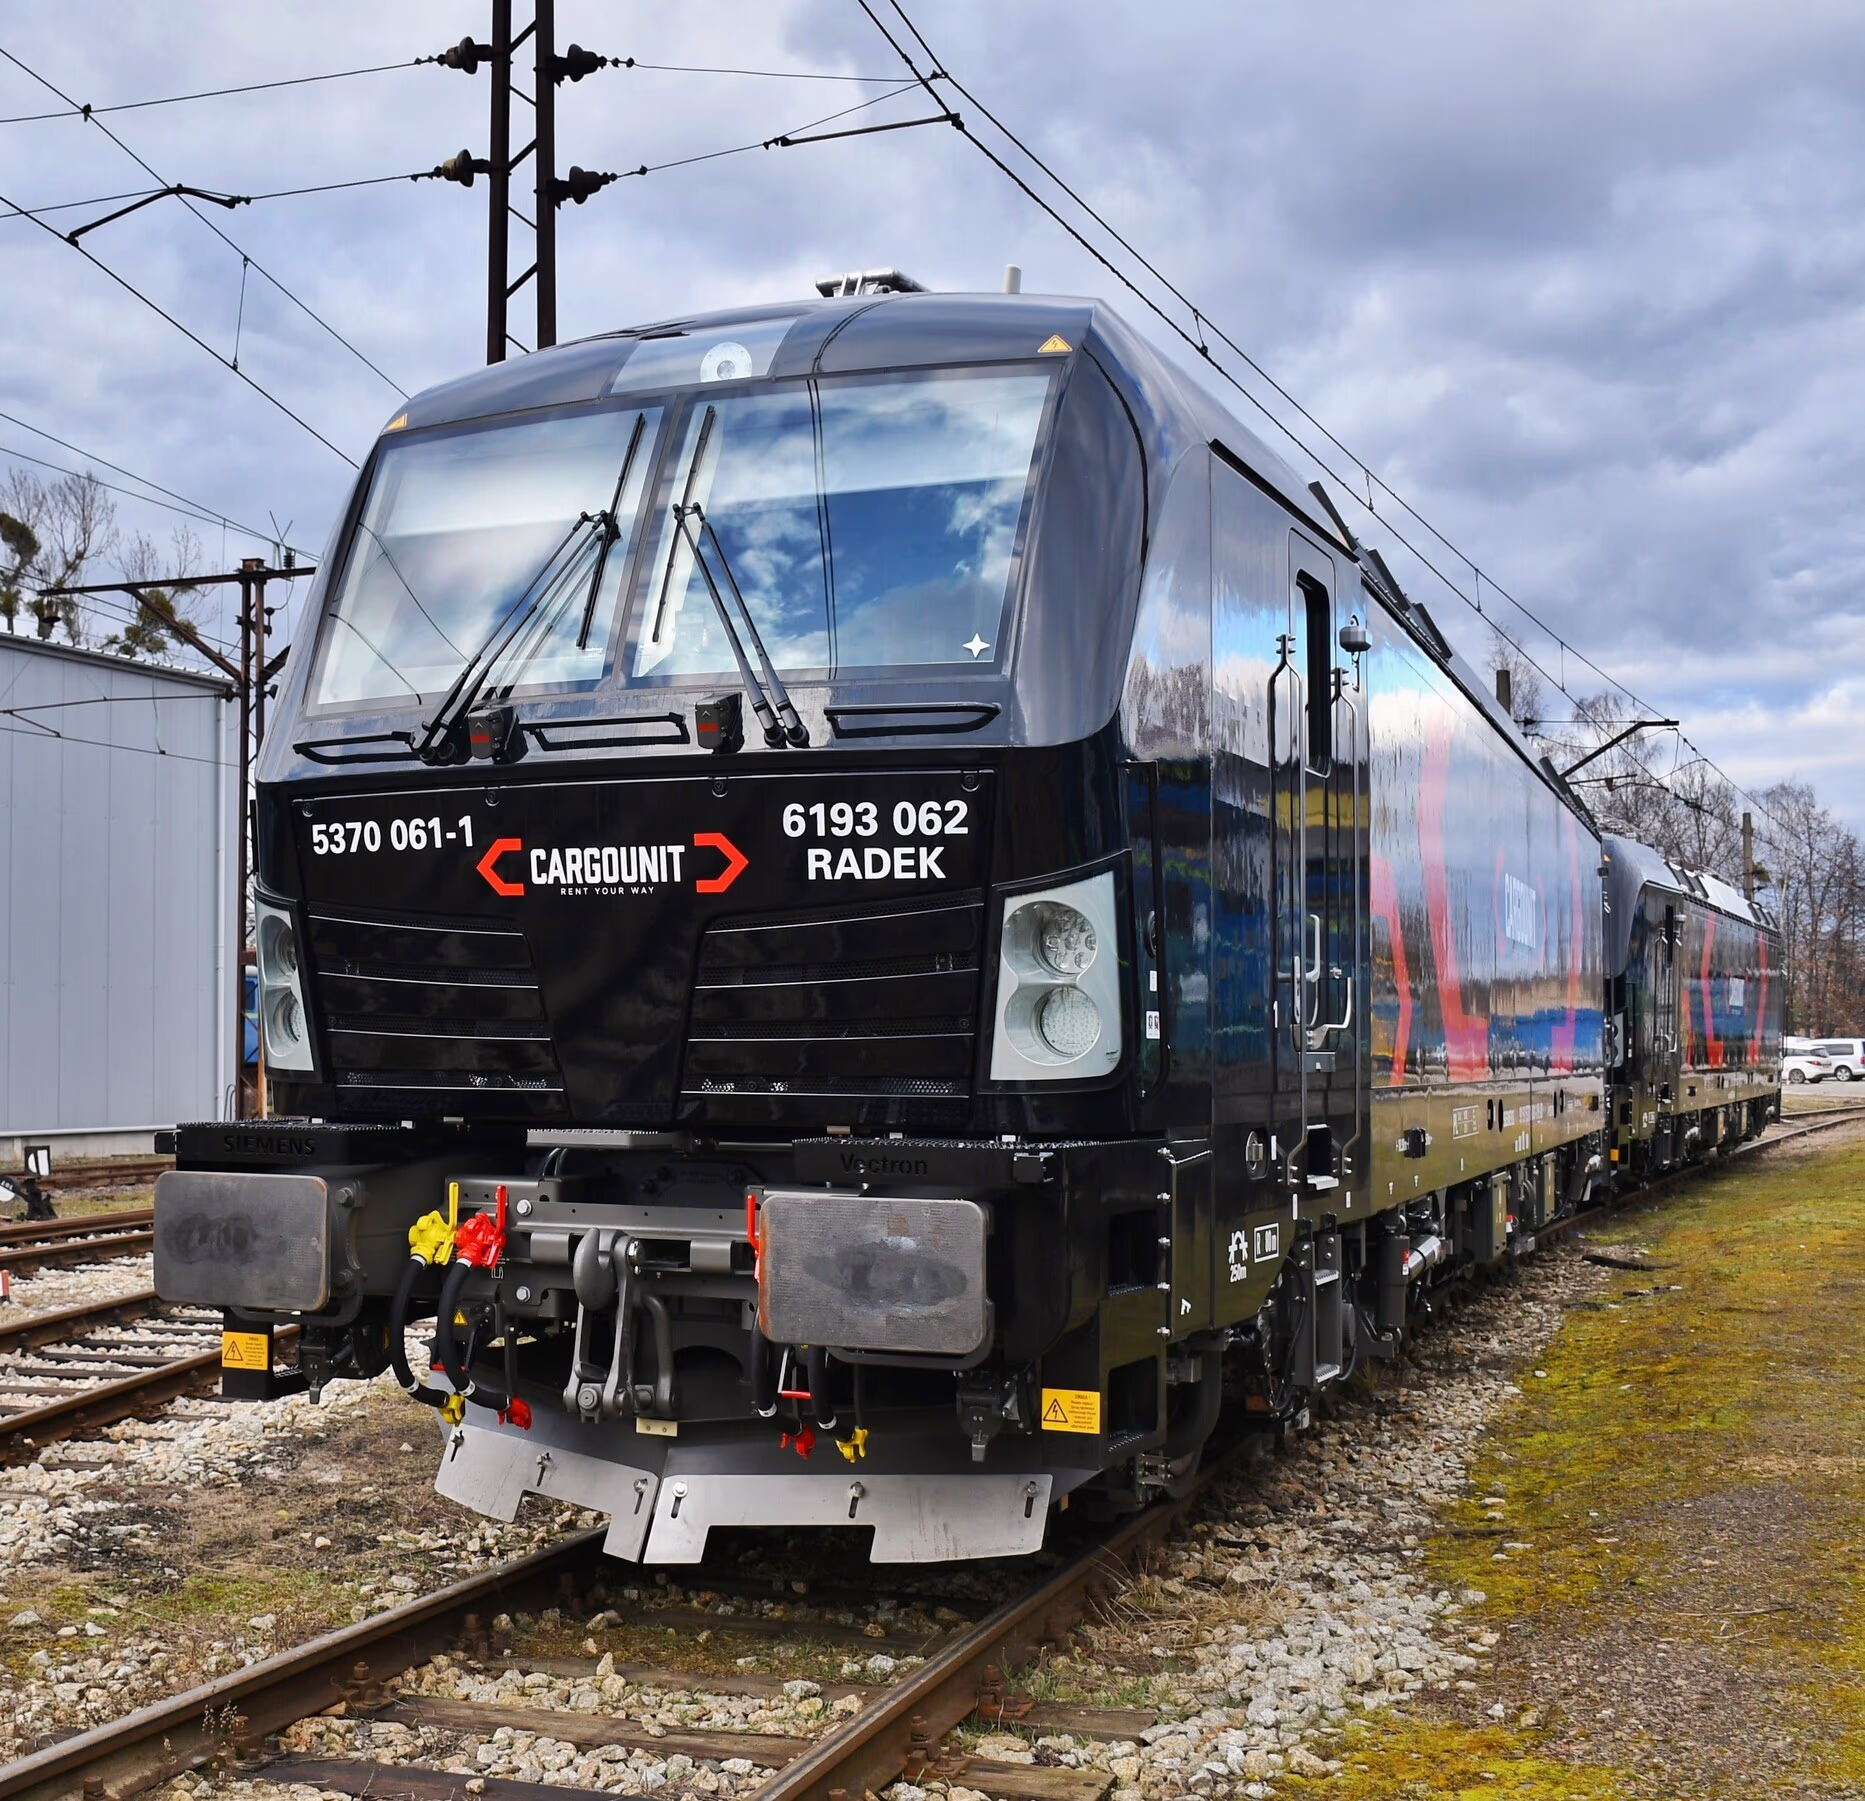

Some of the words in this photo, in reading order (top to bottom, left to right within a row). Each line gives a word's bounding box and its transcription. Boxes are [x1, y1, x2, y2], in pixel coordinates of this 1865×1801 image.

[782, 801, 879, 838] 6193
[892, 798, 969, 836] 062
[310, 819, 382, 855] 5370
[390, 815, 474, 851] 061-1
[530, 844, 686, 886] CARGOUNIT
[807, 846, 947, 881] RADEK
[560, 887, 589, 896] RENT
[594, 886, 625, 896] YOUR
[630, 886, 655, 895] WAY
[223, 1135, 317, 1156] SIEMENS
[840, 1152, 929, 1176] Vectron
[1229, 1263, 1247, 1283] 250m
